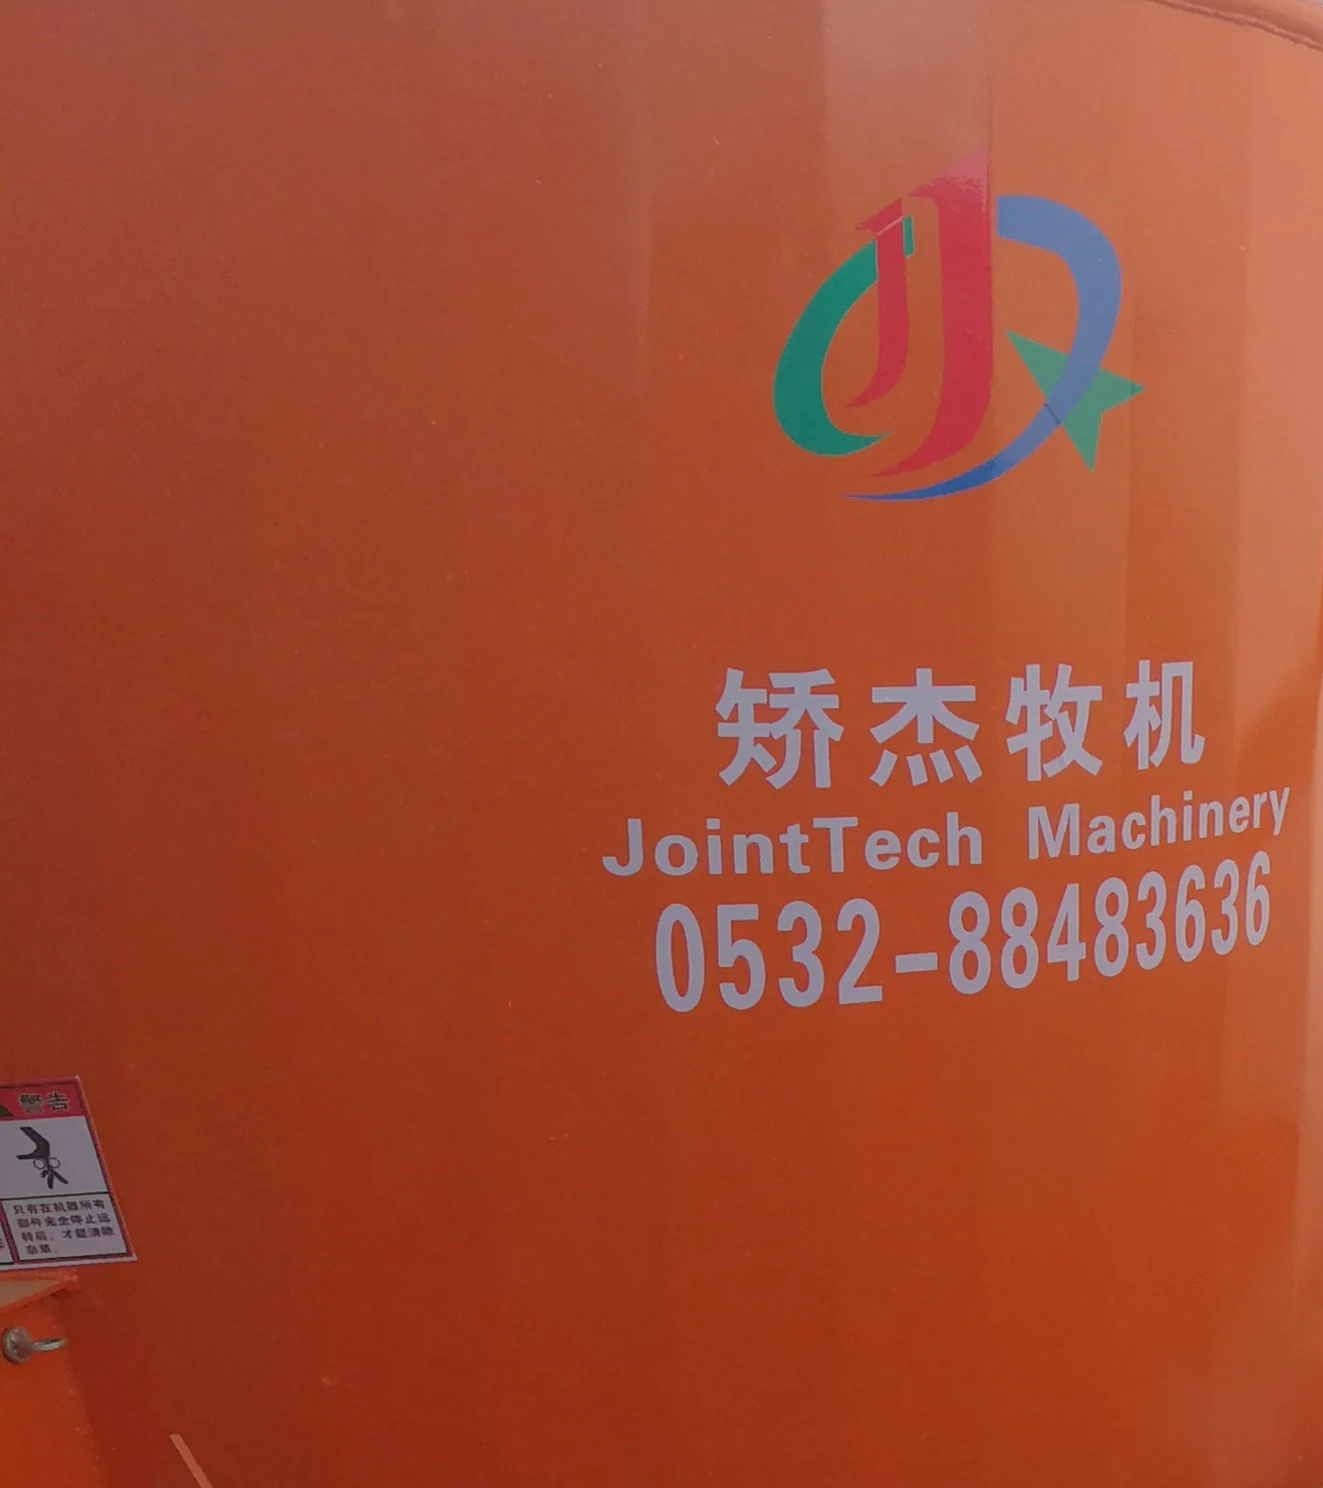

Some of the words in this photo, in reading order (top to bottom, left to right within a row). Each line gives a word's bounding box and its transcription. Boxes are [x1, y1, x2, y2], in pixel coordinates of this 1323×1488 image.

[715, 659, 1206, 790] 矫杰牧机
[601, 811, 984, 877] JointTech
[1027, 787, 1291, 861] Machinery
[655, 850, 1272, 1013] 0532-88483636
